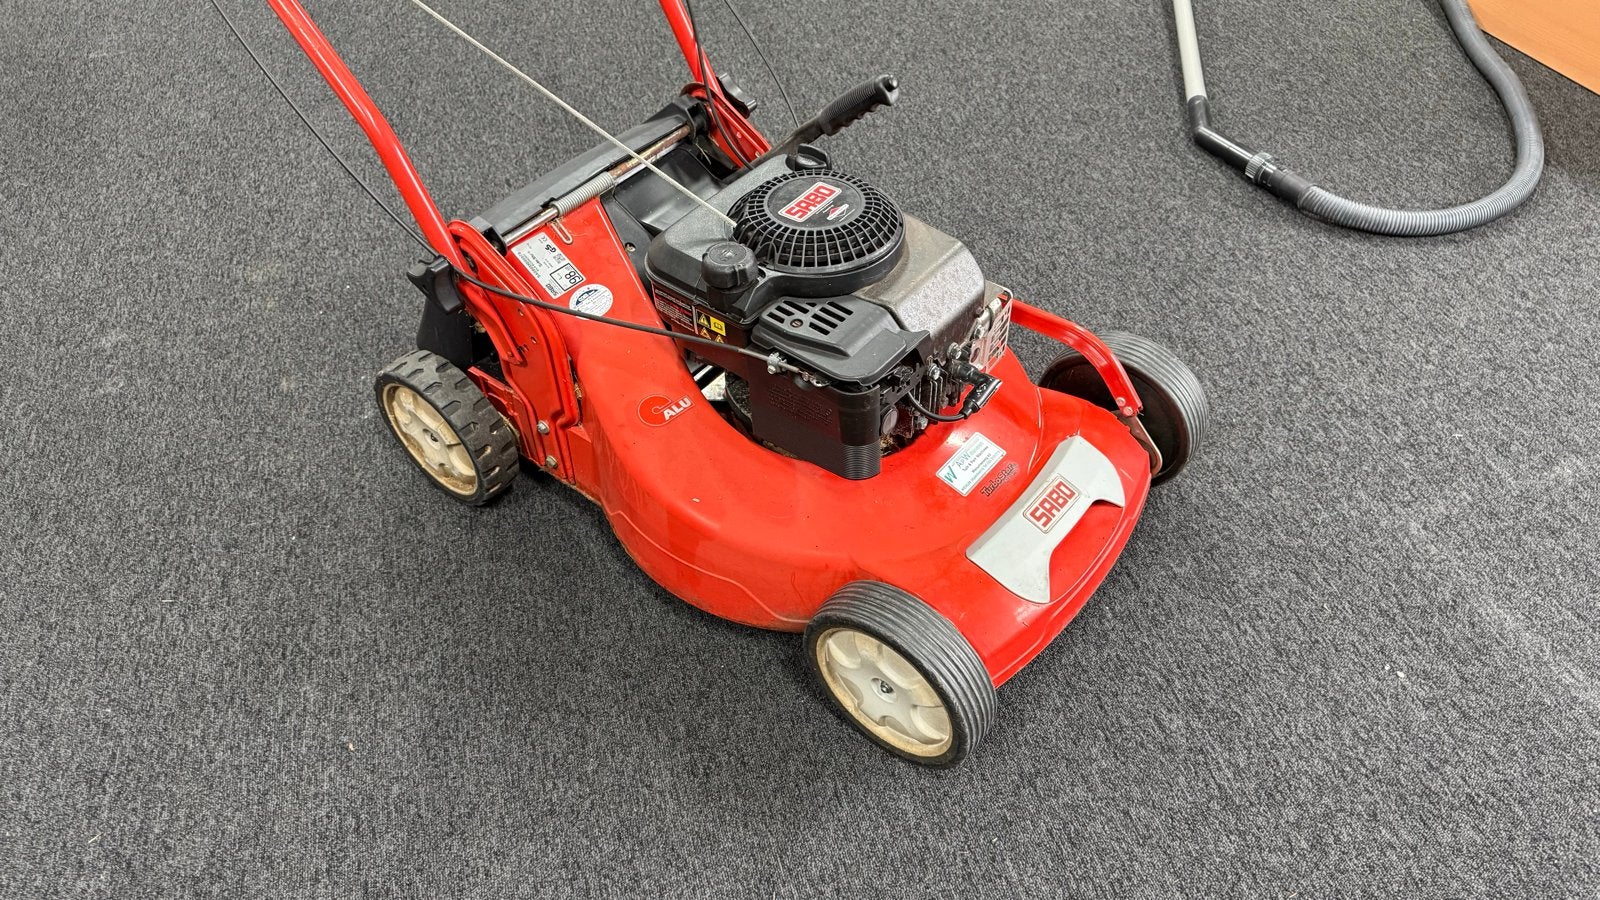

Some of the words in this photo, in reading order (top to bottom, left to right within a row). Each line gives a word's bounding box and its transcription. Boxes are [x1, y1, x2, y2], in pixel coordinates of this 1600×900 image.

[784, 185, 837, 219] SABO
[564, 270, 581, 285] 98
[662, 397, 692, 421] ALU
[980, 463, 1015, 497] TurboStar
[1029, 481, 1076, 528] SABO
